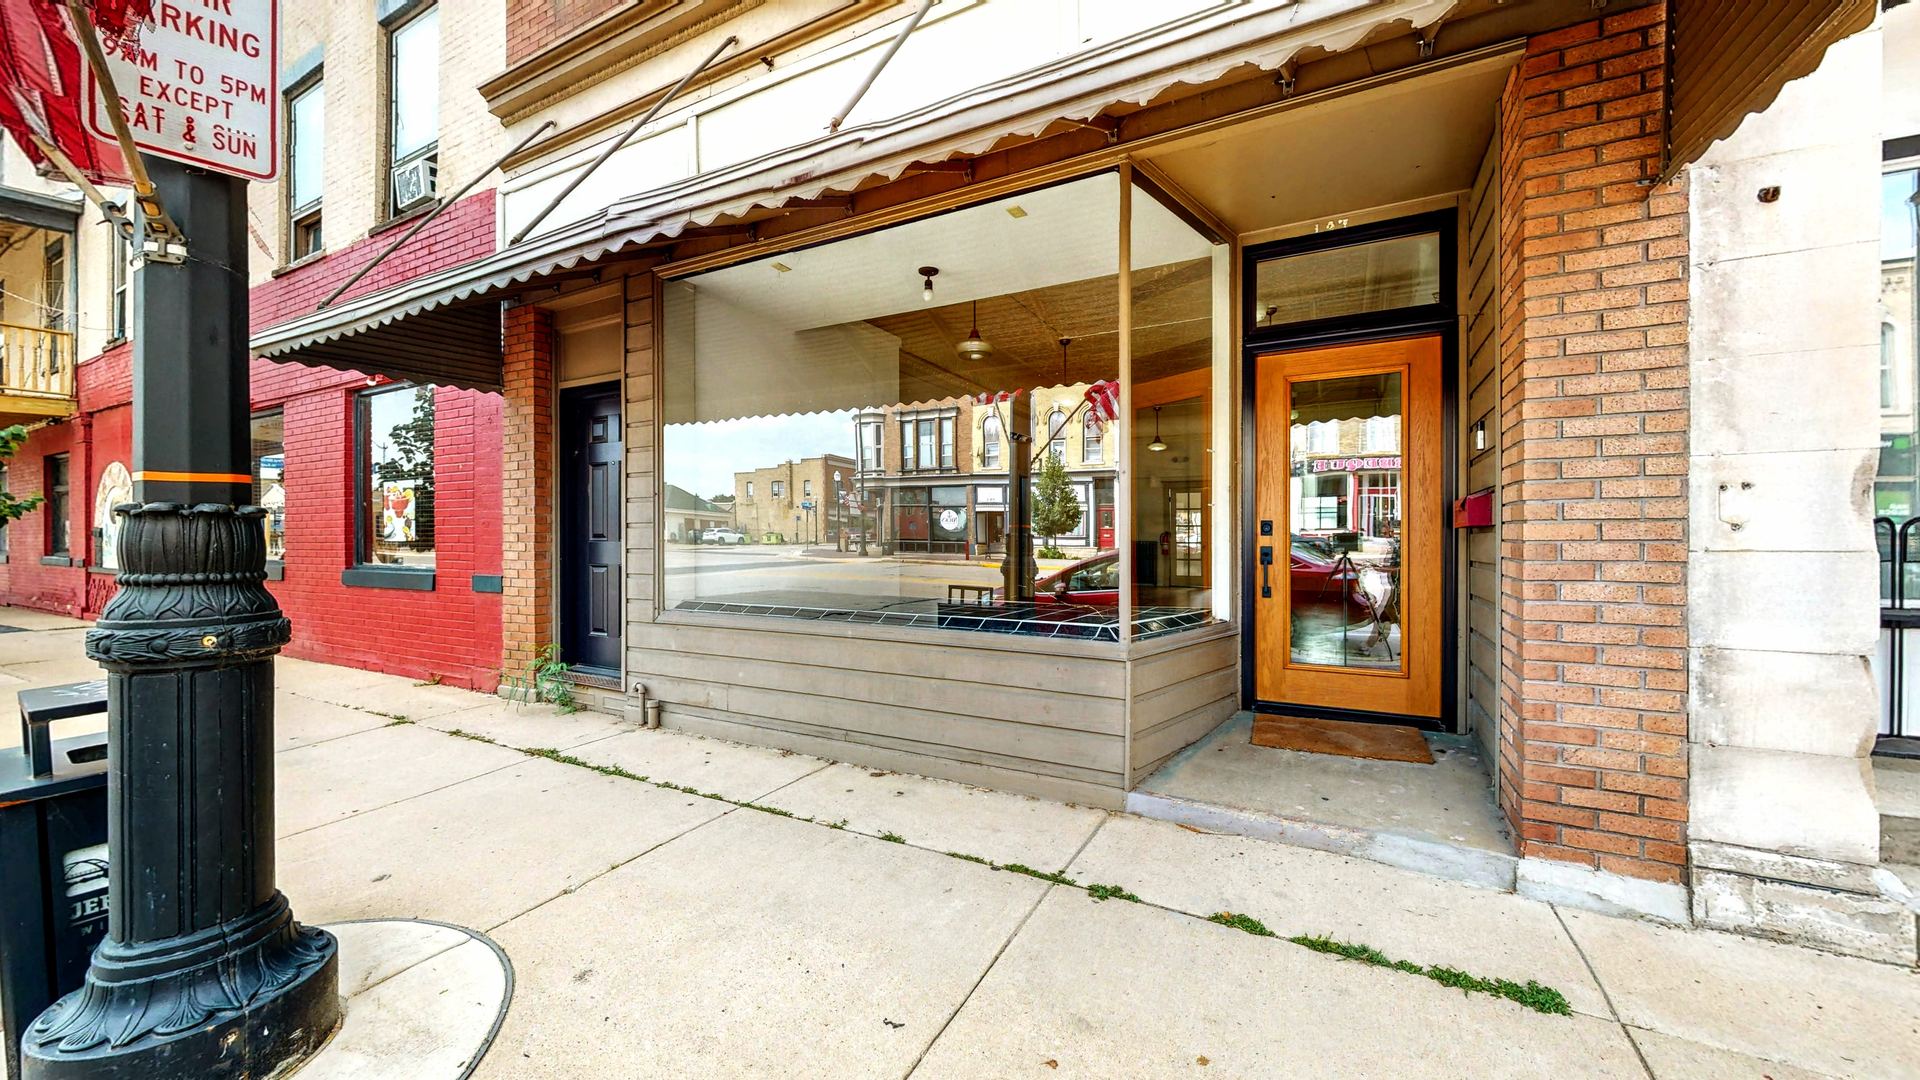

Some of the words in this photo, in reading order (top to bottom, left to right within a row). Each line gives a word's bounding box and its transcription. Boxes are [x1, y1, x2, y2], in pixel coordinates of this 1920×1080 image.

[147, 3, 260, 58] RKING
[140, 75, 233, 119] EXCEPT
[174, 59, 204, 85] TO
[220, 74, 266, 105] 5PM
[182, 116, 196, 144] &
[212, 125, 256, 160] SUN
